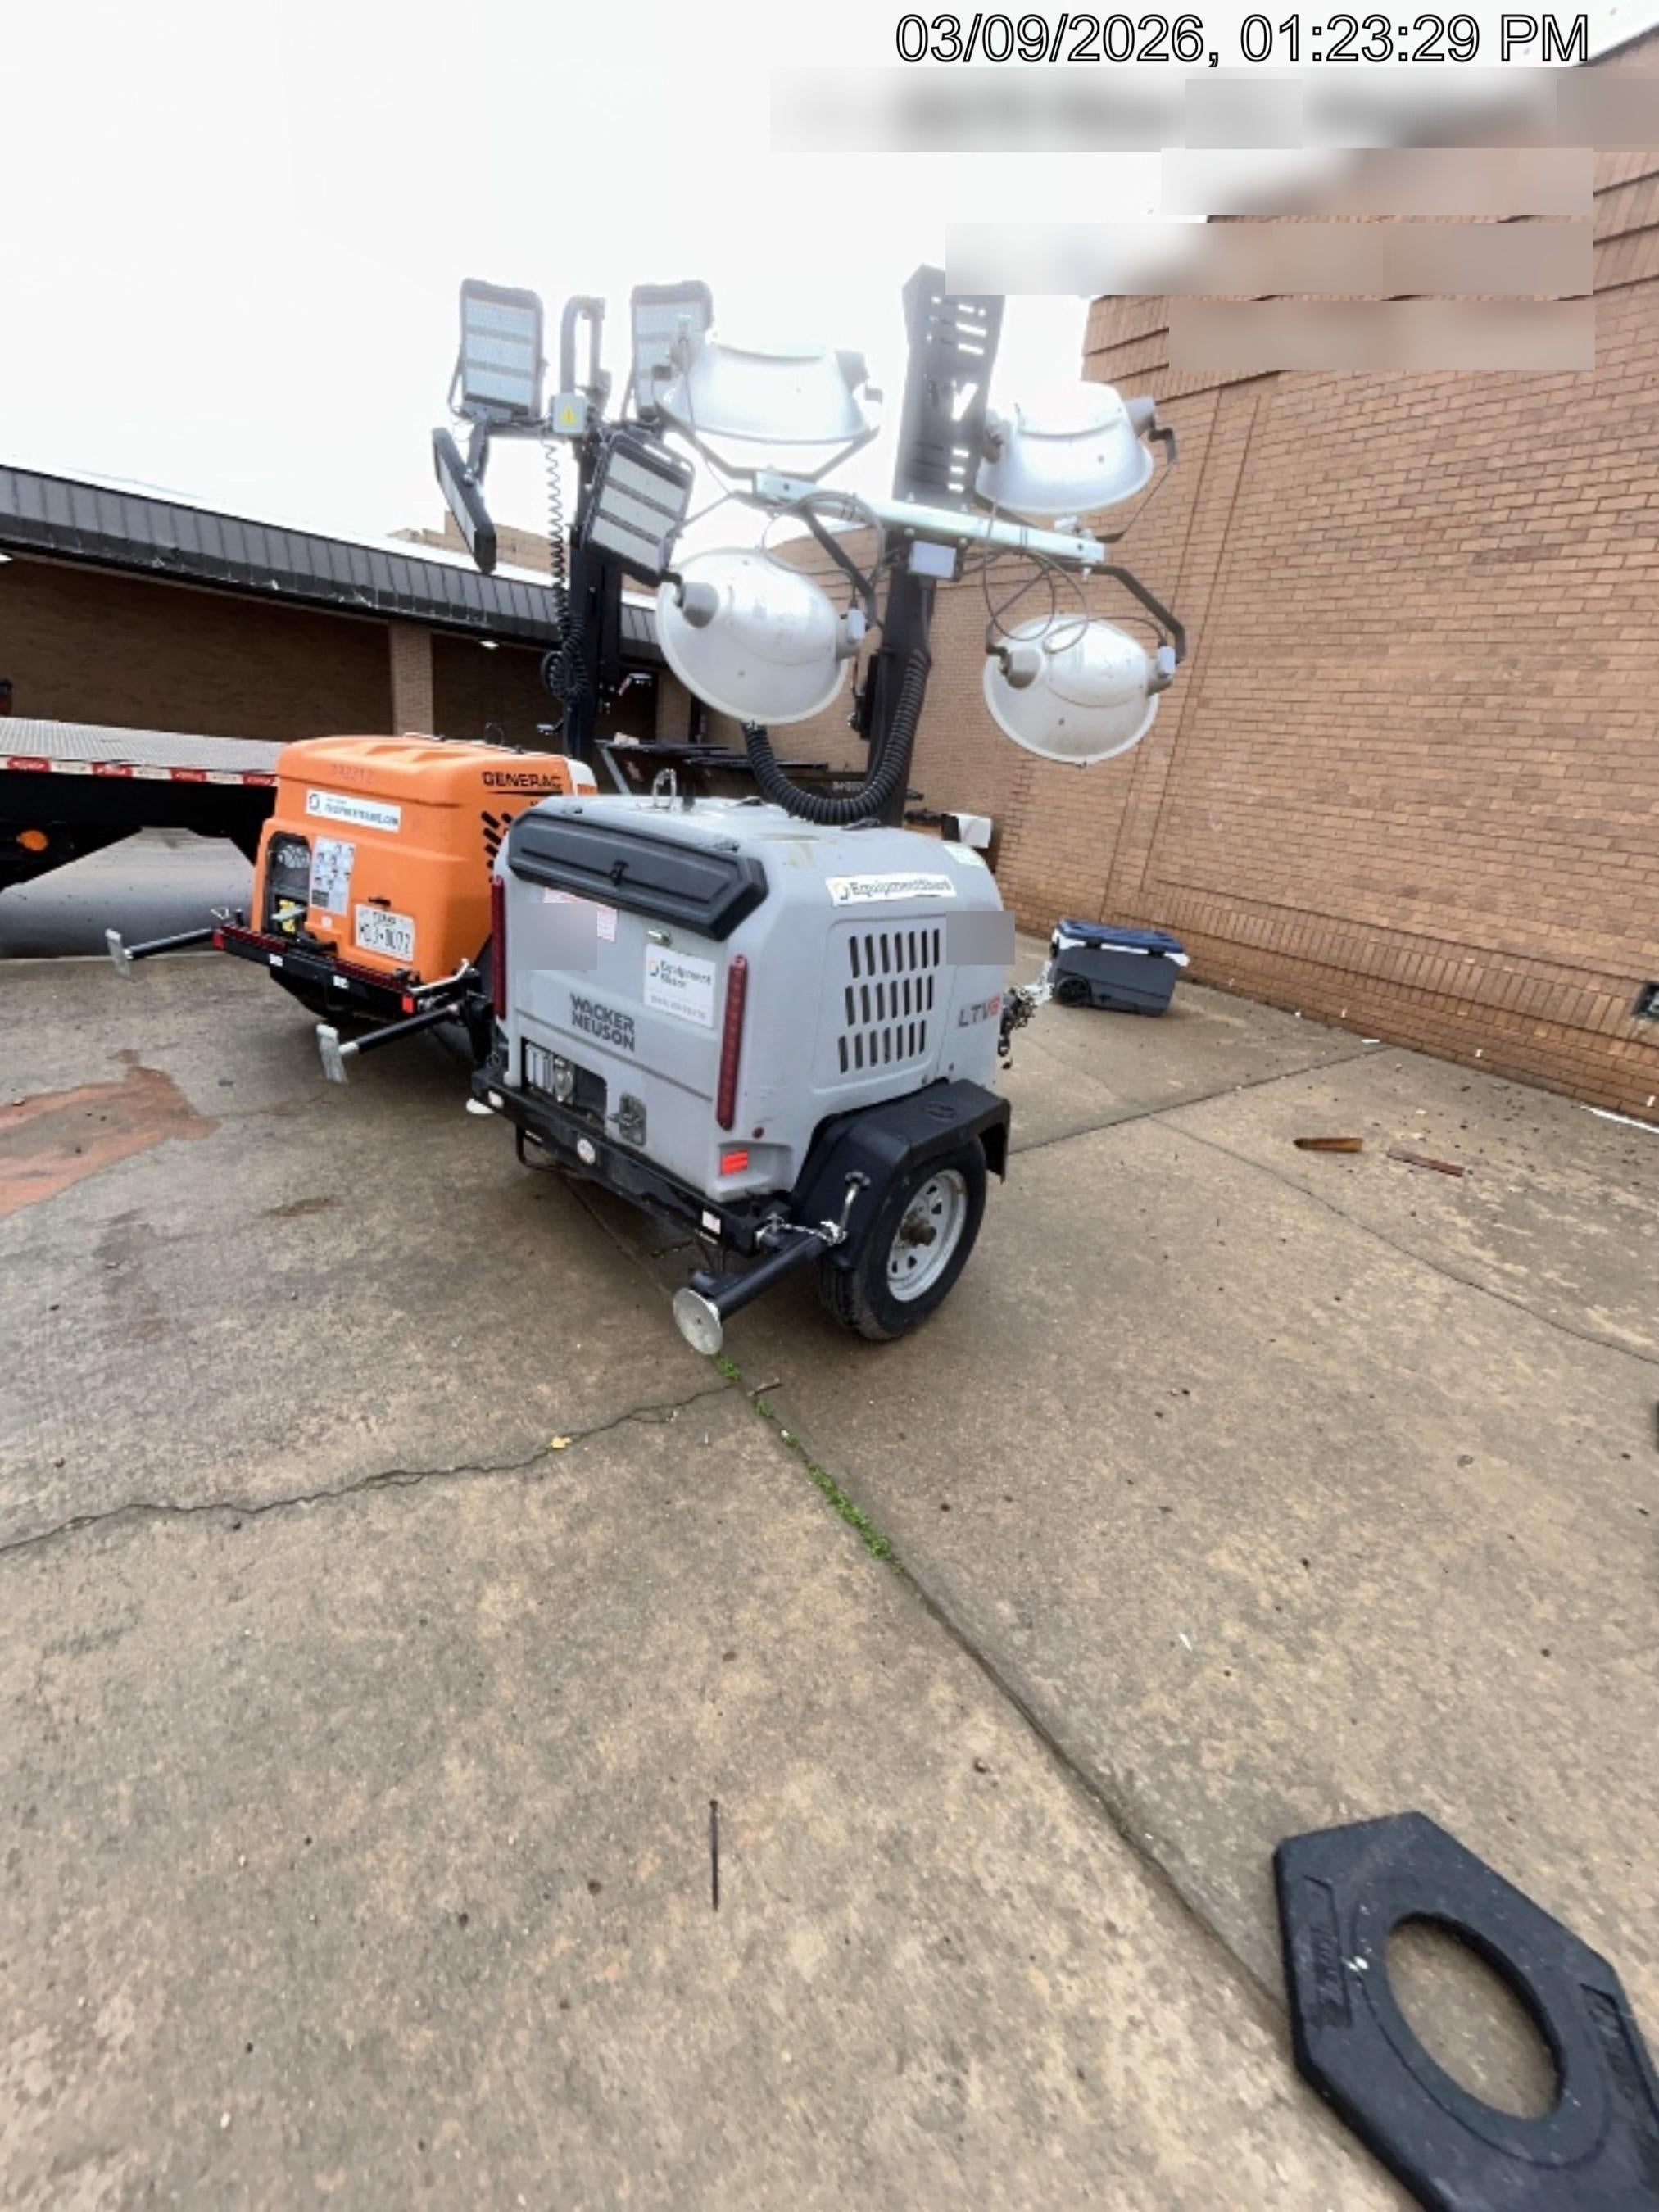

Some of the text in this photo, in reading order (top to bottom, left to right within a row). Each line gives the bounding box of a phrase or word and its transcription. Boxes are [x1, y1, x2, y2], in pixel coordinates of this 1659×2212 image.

[482, 771, 562, 789] GENERAC
[570, 992, 635, 1036] WACKER
[572, 1009, 635, 1053] NEUSON
